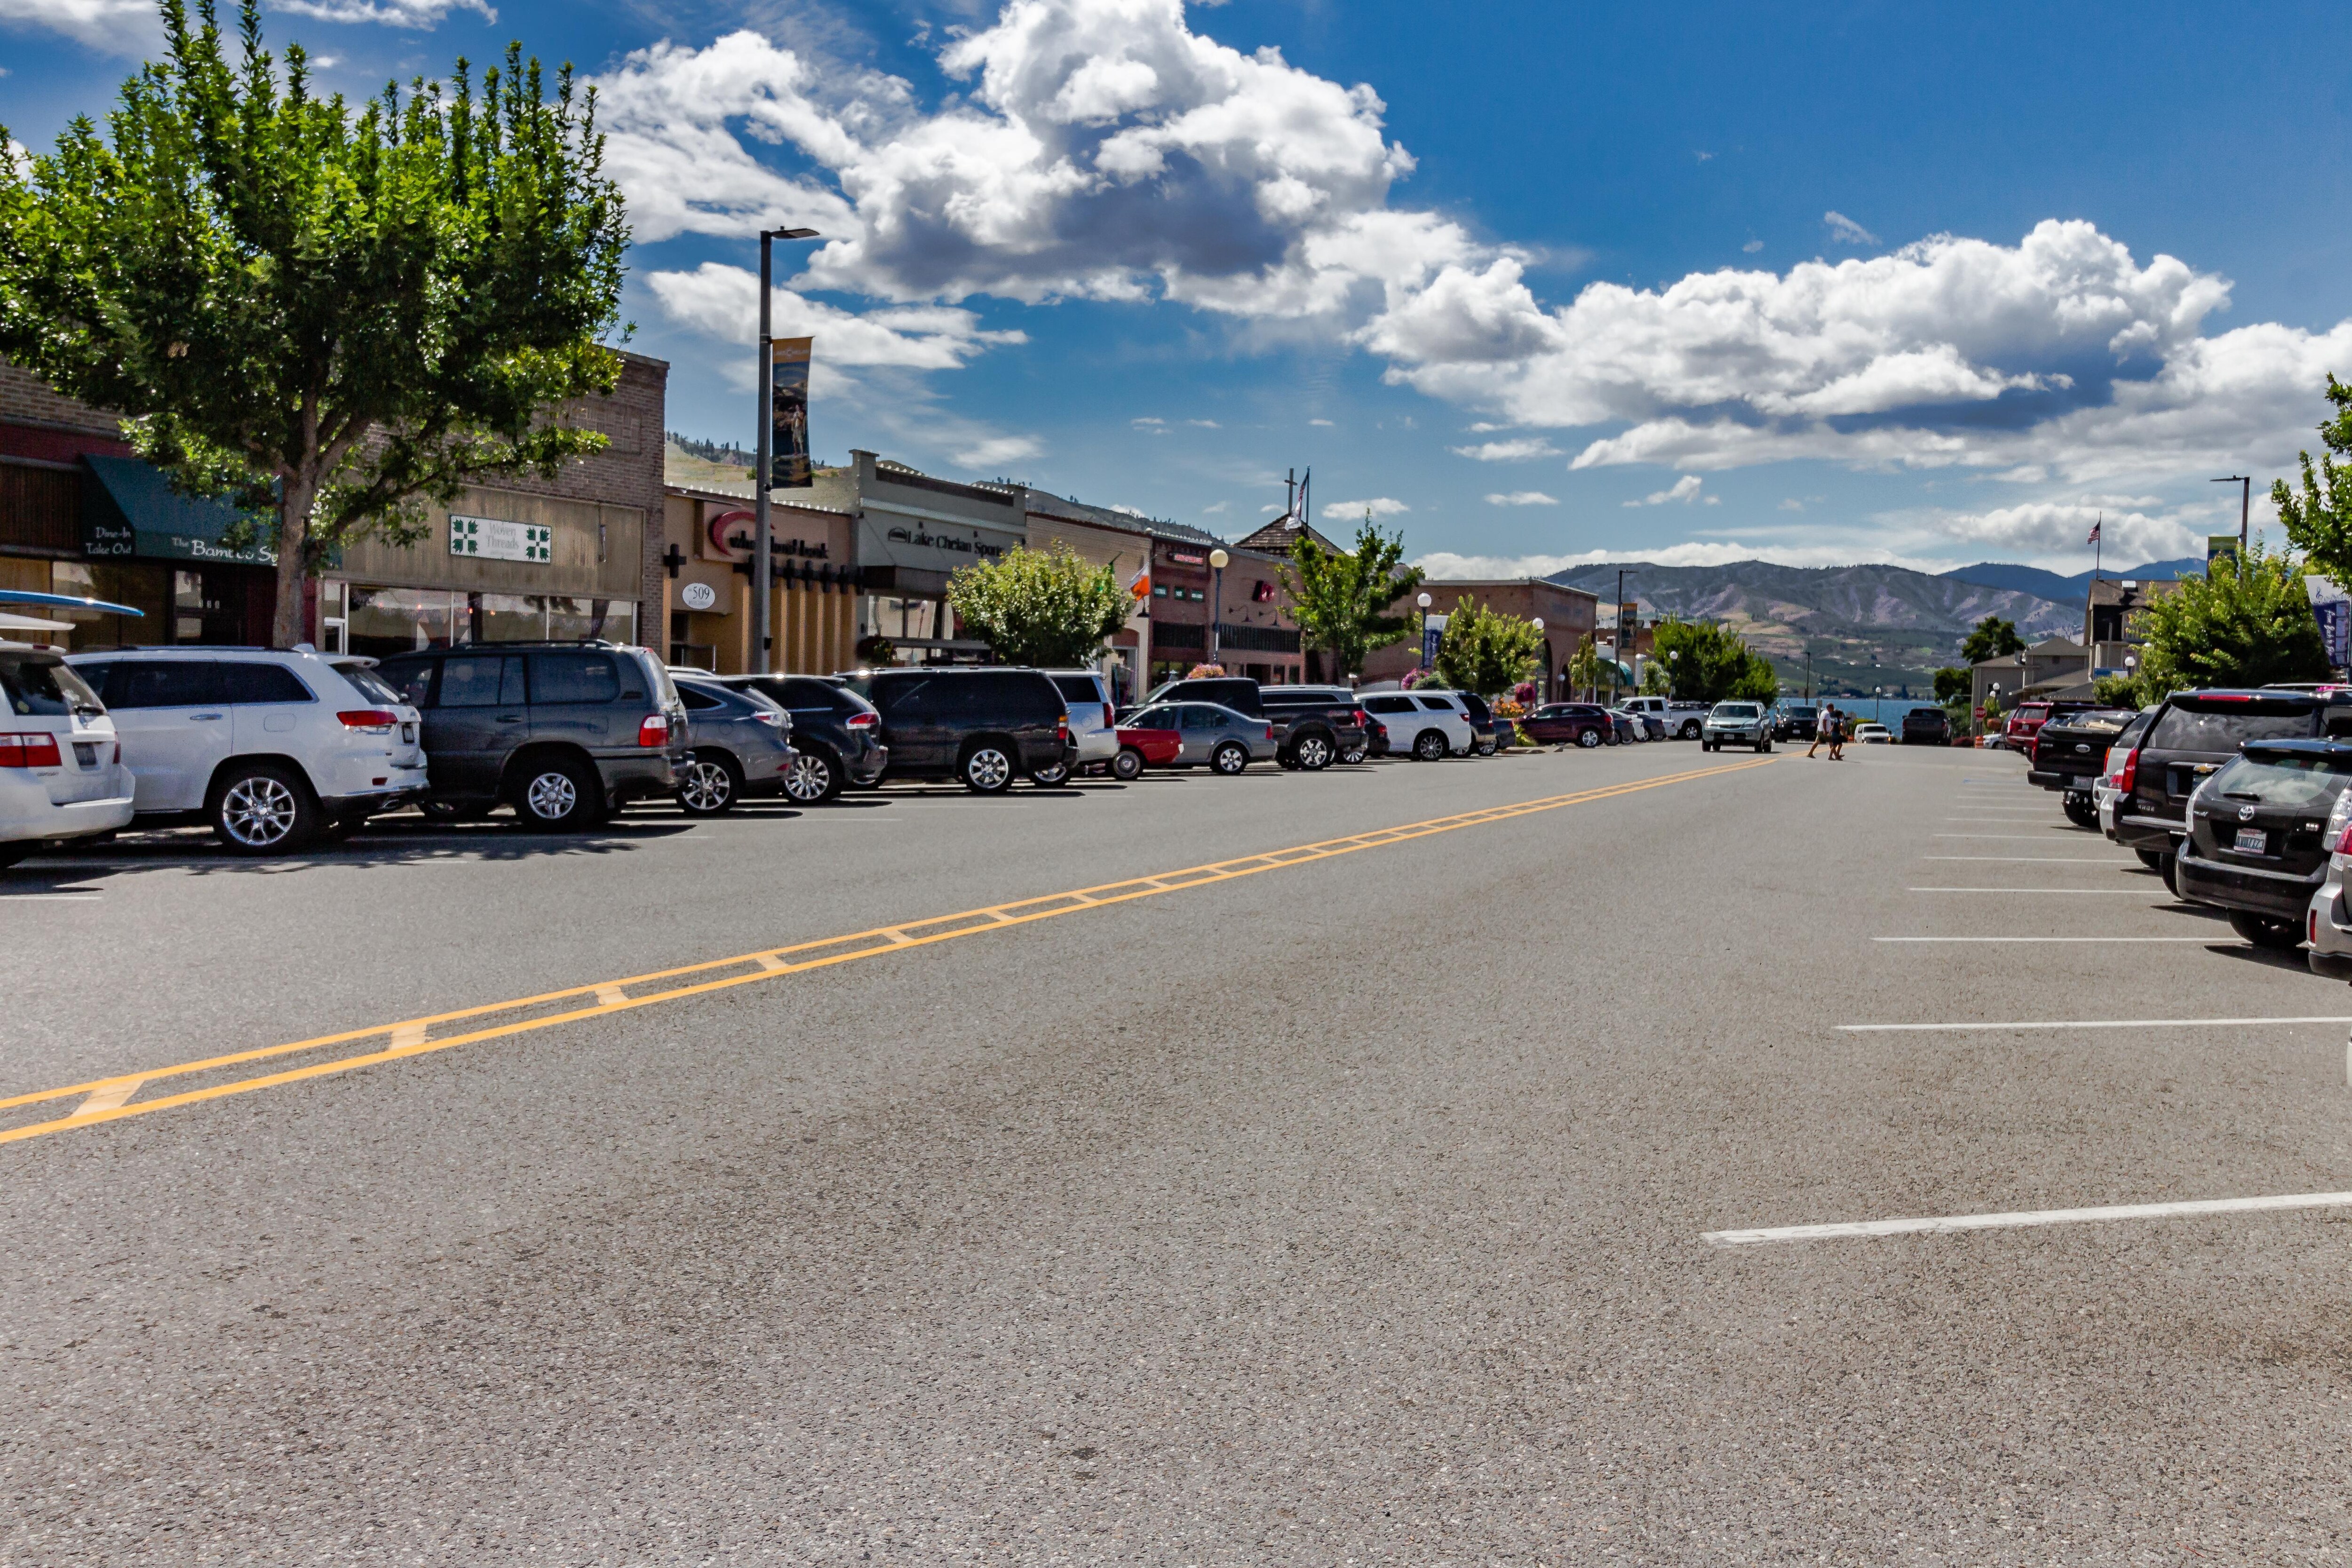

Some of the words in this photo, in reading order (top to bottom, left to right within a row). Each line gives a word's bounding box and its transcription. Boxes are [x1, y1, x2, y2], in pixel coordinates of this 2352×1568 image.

[86, 543, 109, 554] Take
[113, 543, 131, 554] Out
[172, 537, 189, 547] The
[486, 535, 519, 550] Threads
[907, 531, 934, 546] Lake
[937, 535, 972, 553] Chelan
[693, 586, 710, 600] 509
